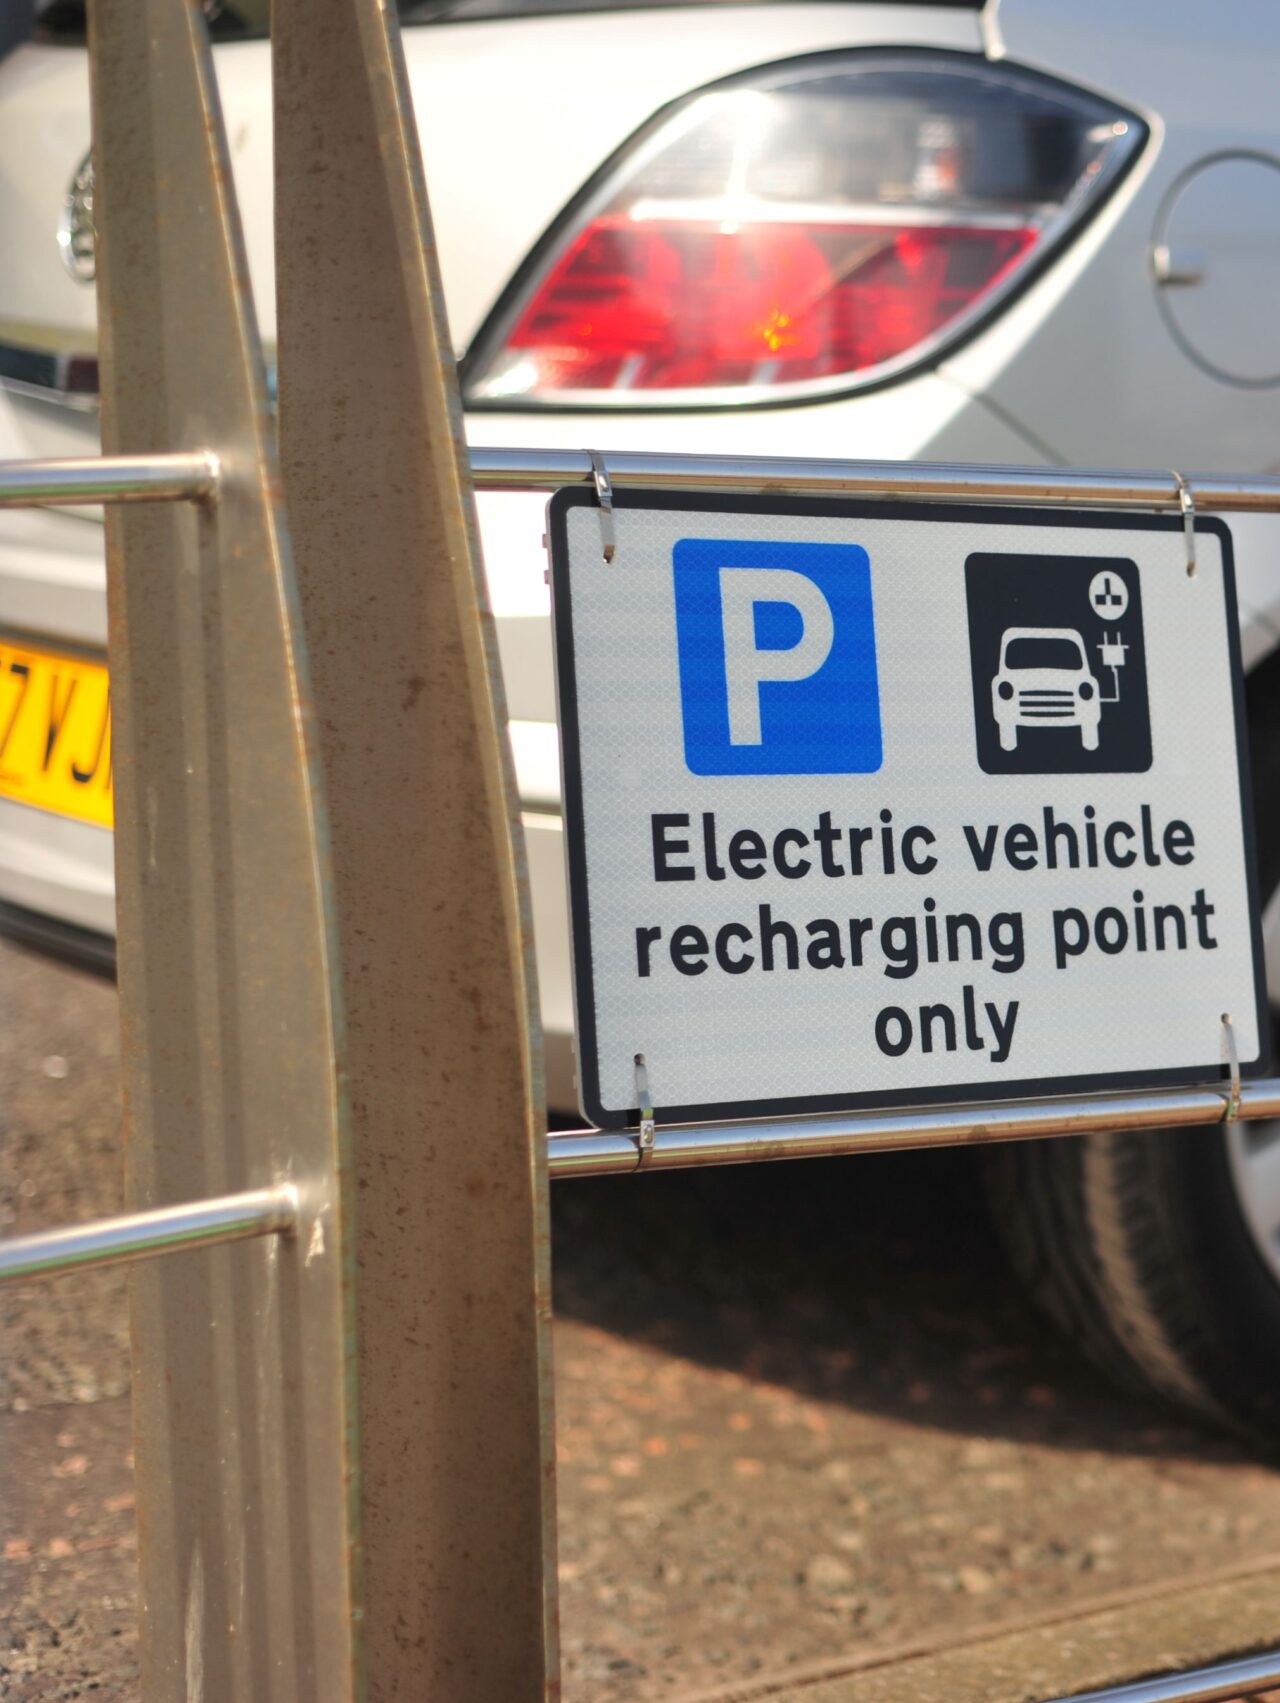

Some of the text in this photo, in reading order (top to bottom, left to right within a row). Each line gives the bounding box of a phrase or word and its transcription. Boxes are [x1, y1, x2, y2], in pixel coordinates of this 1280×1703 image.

[717, 566, 835, 747] P
[650, 804, 1195, 882] Electric vehicle
[635, 888, 1218, 980] recharging point
[874, 984, 1020, 1063] only
